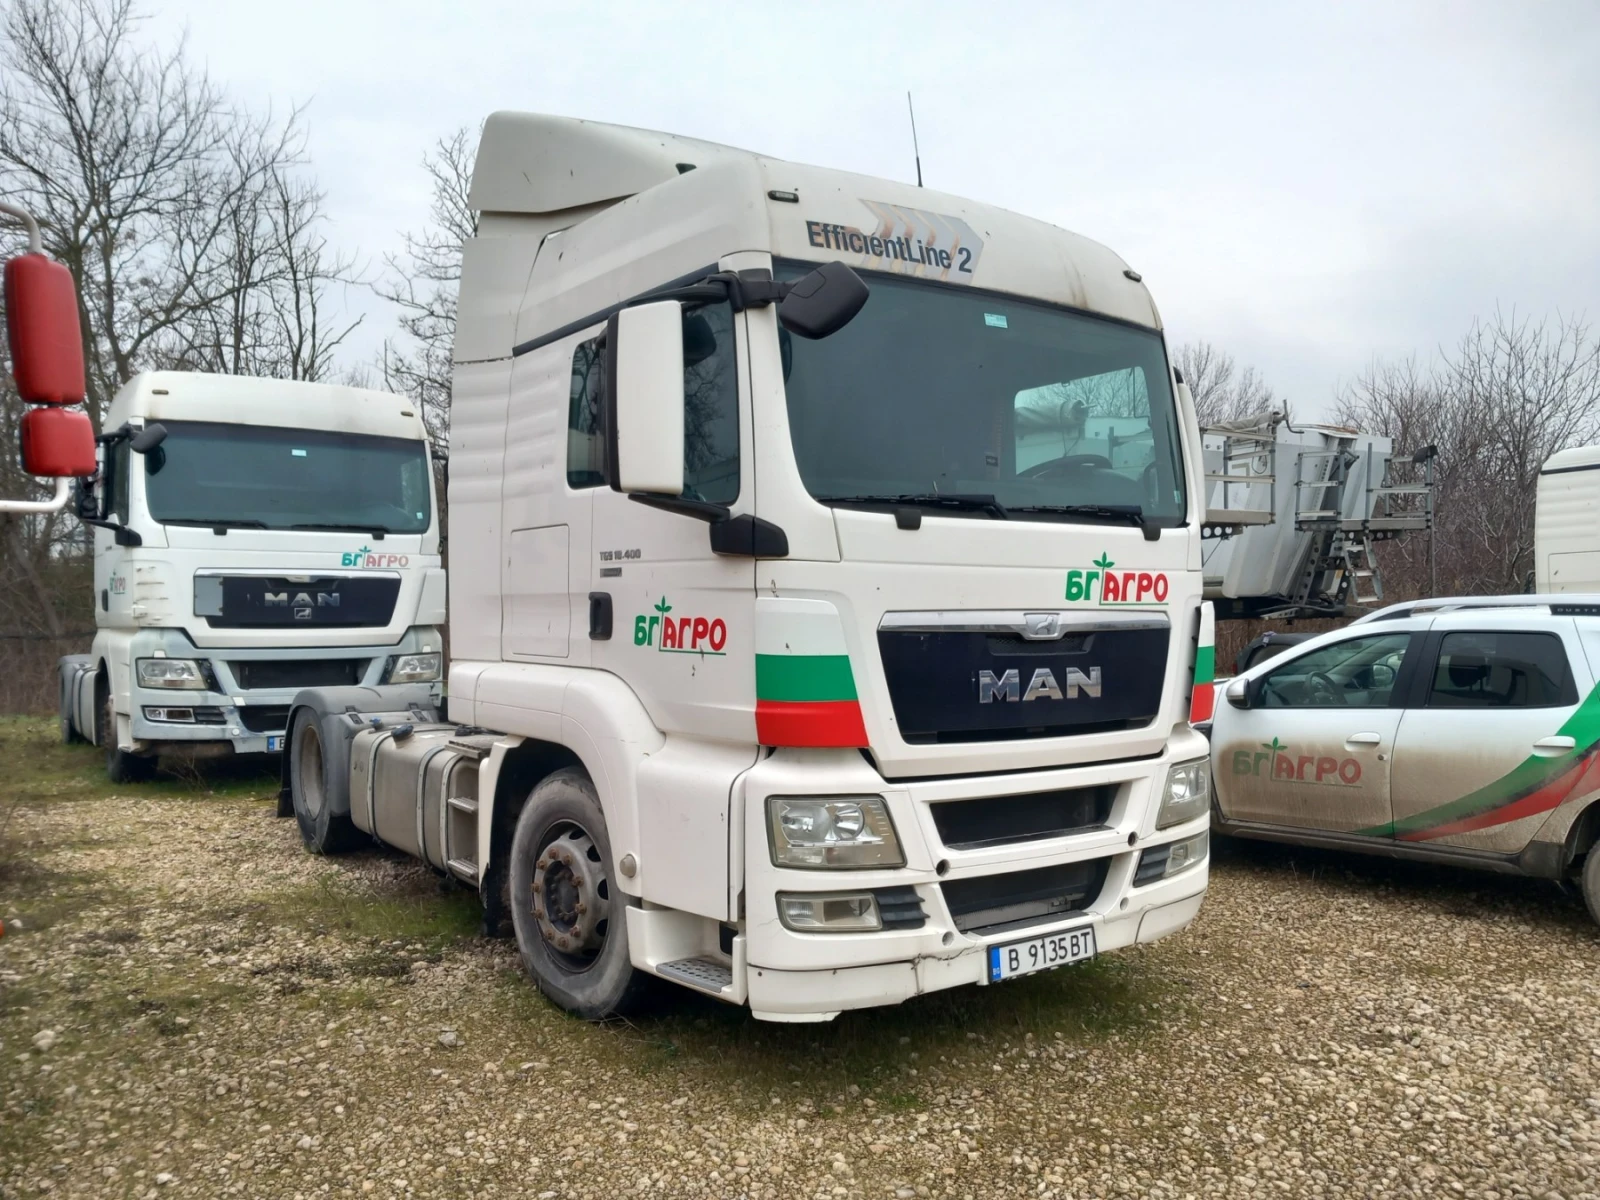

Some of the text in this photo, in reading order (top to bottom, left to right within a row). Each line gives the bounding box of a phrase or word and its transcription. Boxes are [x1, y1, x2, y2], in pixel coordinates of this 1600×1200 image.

[806, 220, 973, 273] EfficientLine 2
[264, 592, 340, 607] MAN
[978, 666, 1102, 704] MAN
